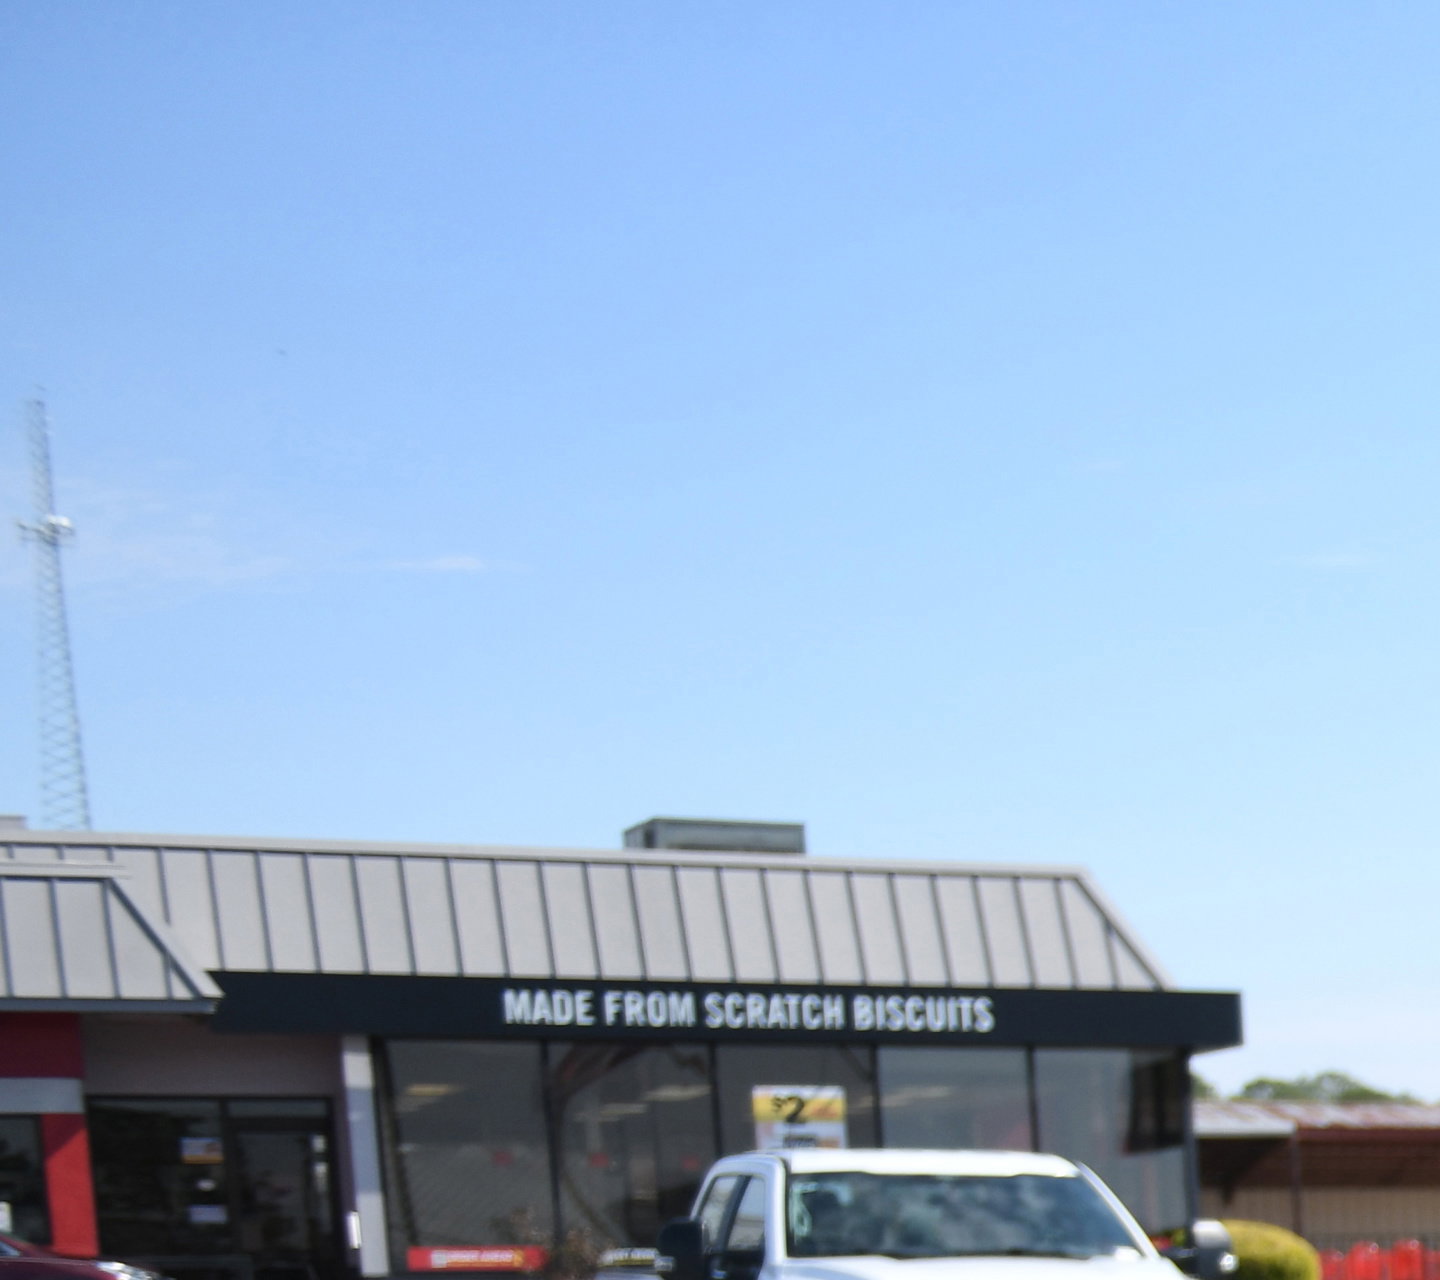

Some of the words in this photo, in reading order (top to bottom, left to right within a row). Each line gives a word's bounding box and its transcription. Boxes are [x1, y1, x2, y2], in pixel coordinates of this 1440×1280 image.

[502, 989, 596, 1027] MADE
[604, 990, 697, 1029] FROM
[703, 992, 846, 1031] SCRATCH
[852, 994, 996, 1034] BISCUITS
